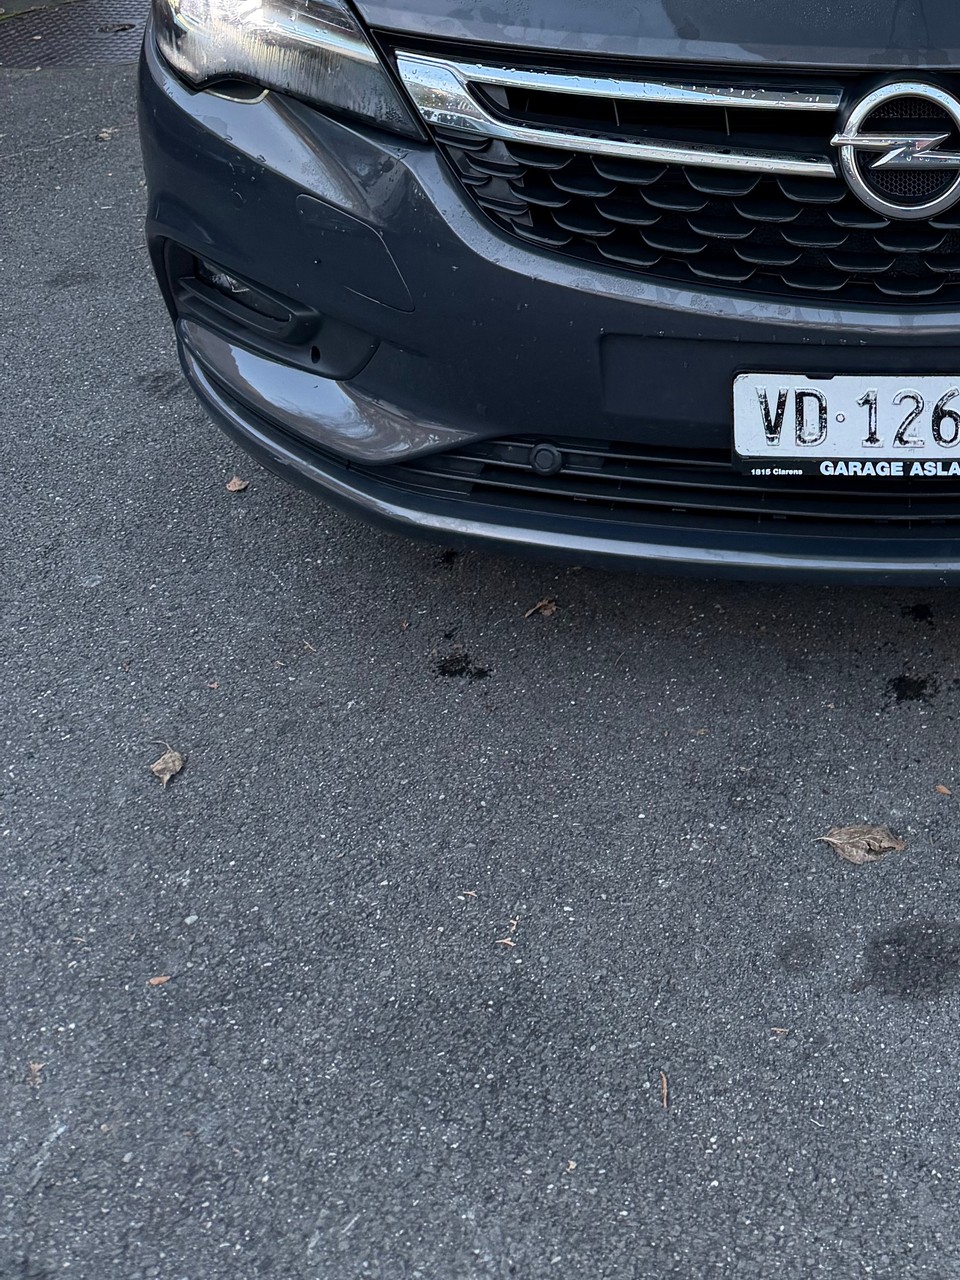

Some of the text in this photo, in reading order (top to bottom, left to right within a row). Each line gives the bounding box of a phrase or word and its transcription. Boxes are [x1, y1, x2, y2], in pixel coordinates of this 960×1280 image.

[755, 387, 828, 447] VD
[773, 468, 803, 476] Clarens
[820, 460, 904, 476] GARAGE
